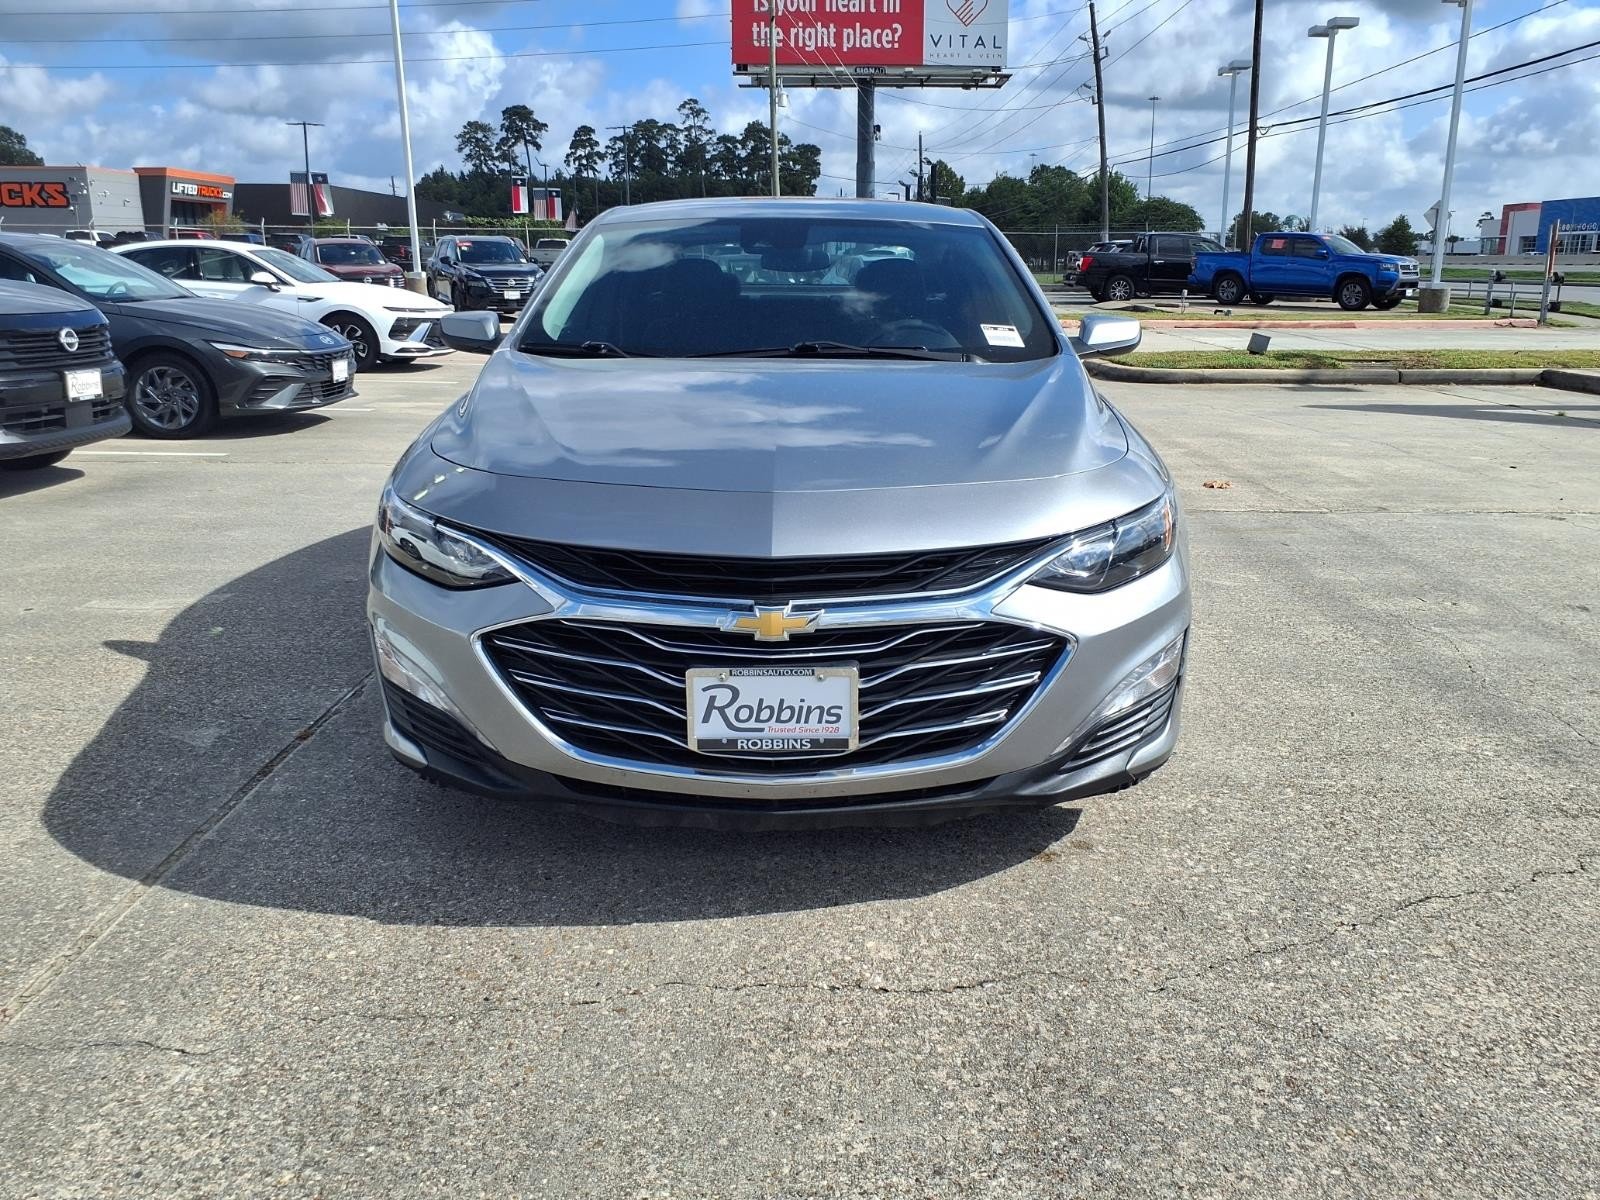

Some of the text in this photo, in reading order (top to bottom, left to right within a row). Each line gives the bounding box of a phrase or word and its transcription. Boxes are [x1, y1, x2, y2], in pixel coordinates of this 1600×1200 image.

[774, 0, 817, 16] your
[751, 22, 903, 53] the right place?
[930, 33, 1003, 50] VITAL
[0, 182, 69, 207] CKS
[731, 669, 813, 677] ROBBINSAUTO.COM
[701, 683, 844, 733] Robbins
[767, 726, 840, 734] Trusted Since 1928
[737, 738, 812, 750] ROBBINS
